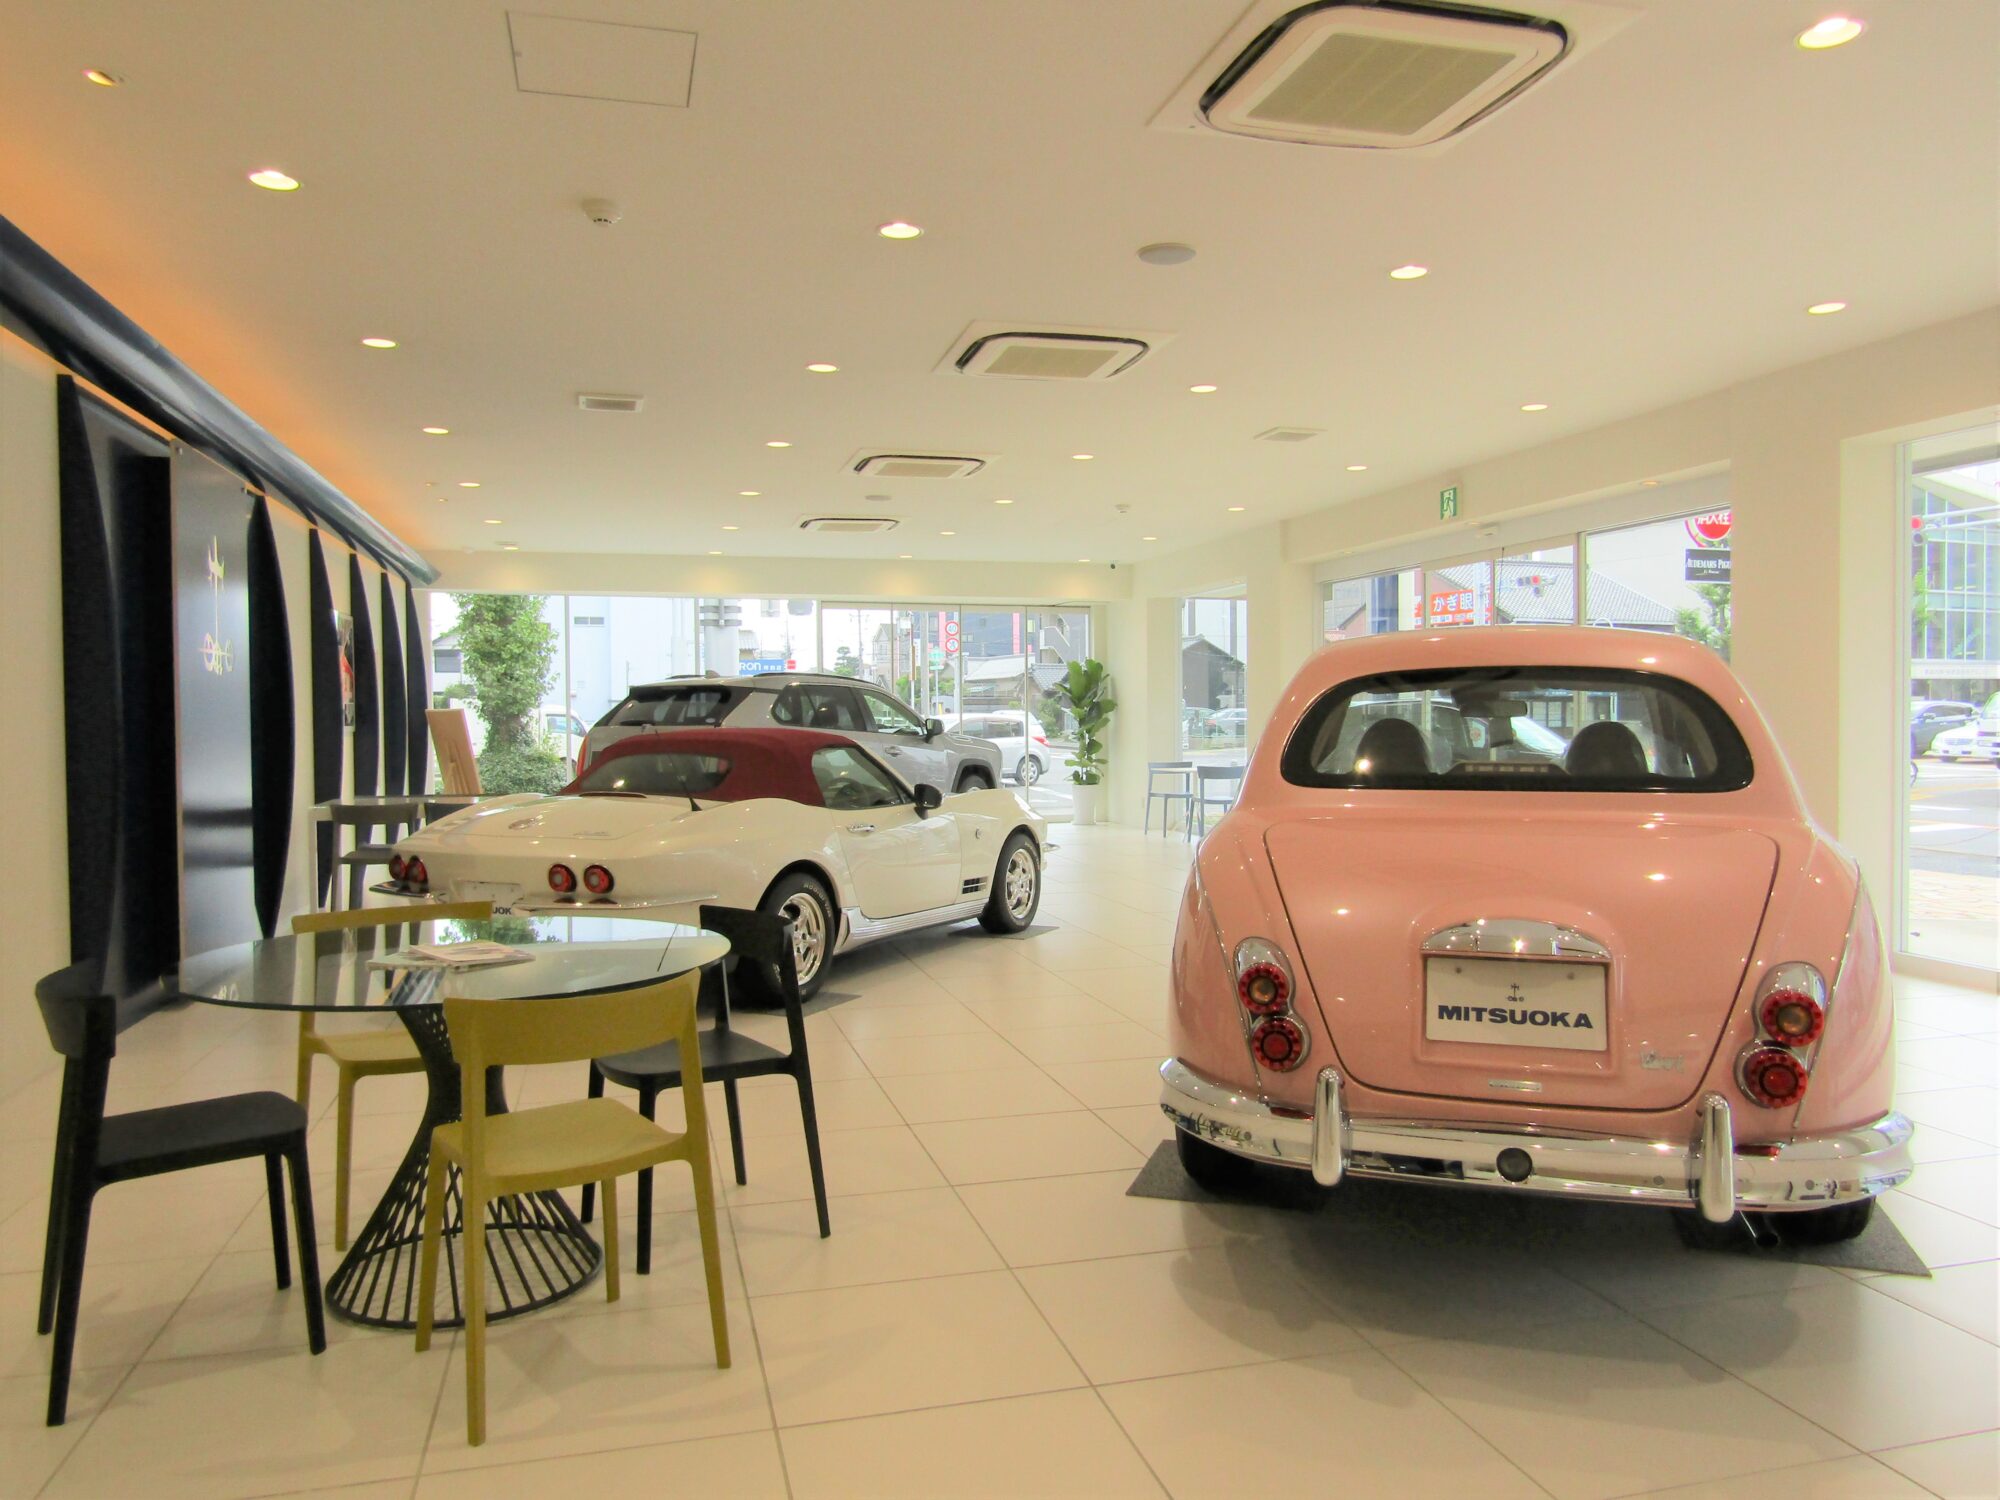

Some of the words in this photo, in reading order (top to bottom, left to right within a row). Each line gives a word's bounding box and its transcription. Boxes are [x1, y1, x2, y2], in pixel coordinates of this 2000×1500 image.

[1433, 592, 1490, 611] かぎ眼
[1438, 1005, 1593, 1028] MITSUOKA
